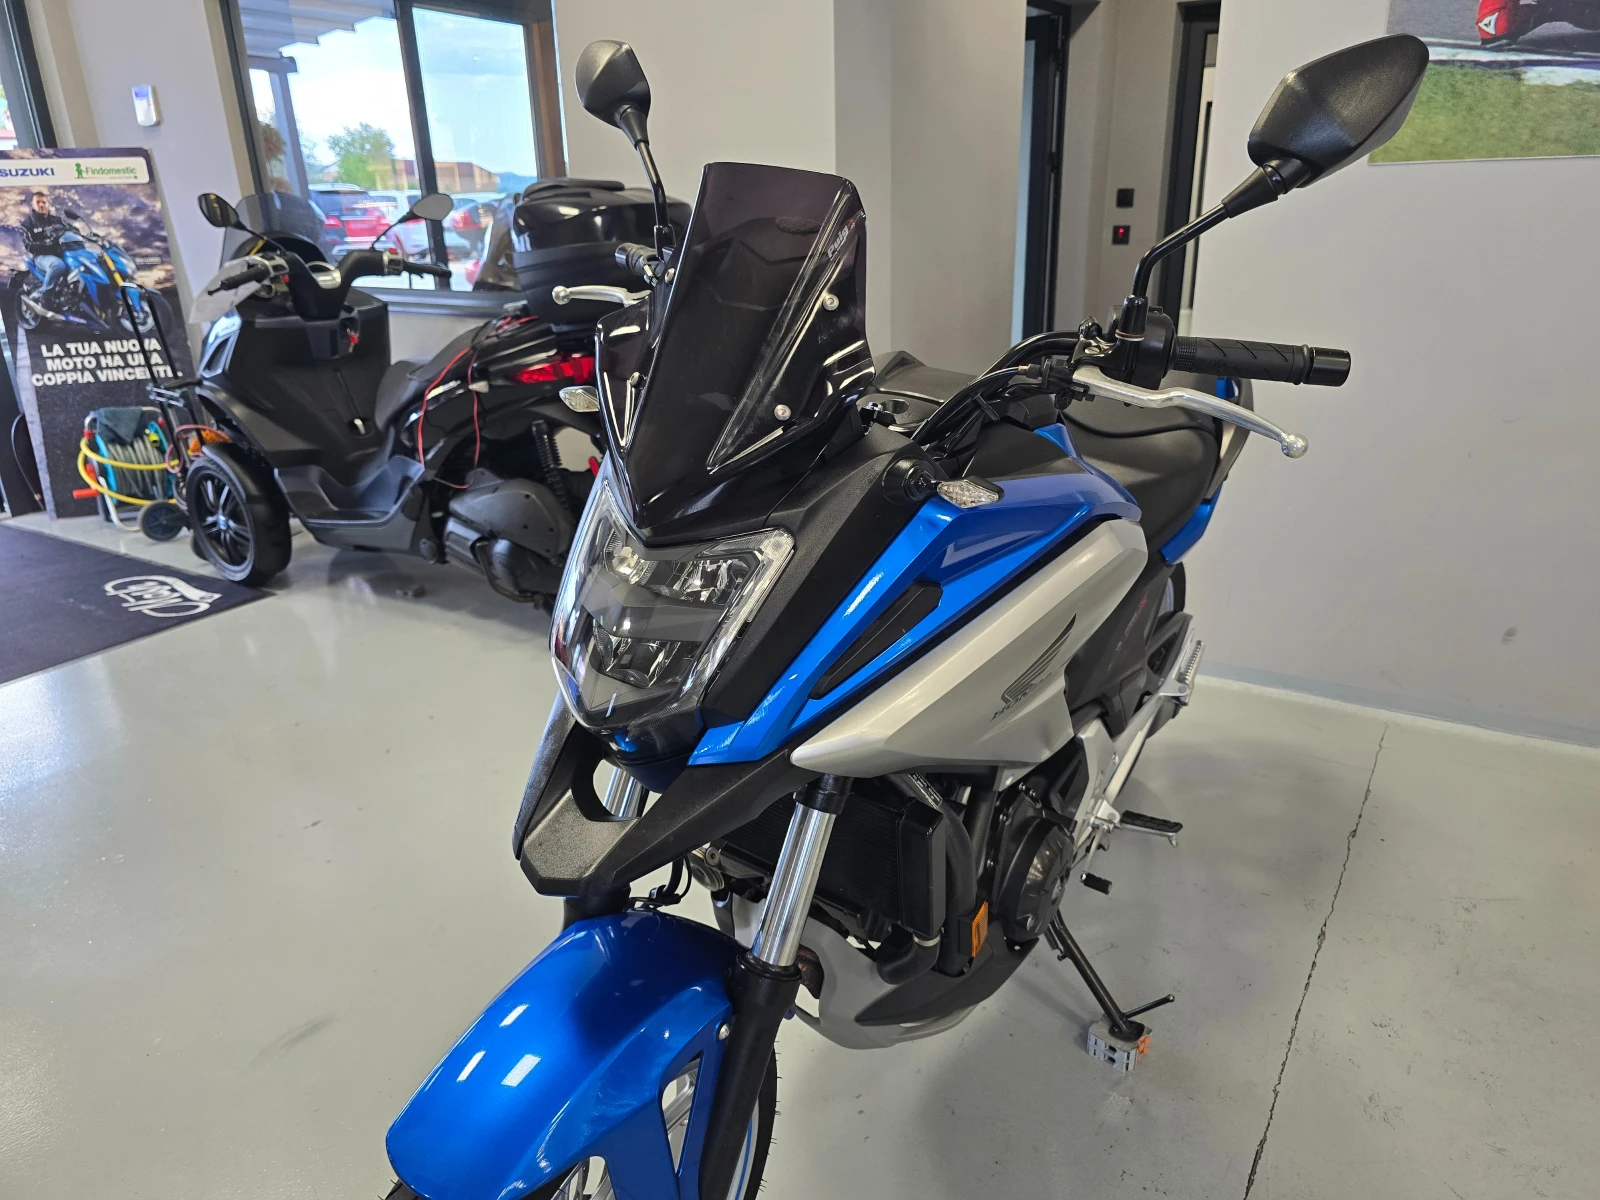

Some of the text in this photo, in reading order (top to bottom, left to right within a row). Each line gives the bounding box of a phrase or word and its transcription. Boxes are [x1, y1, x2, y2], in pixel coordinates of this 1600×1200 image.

[0, 167, 55, 177] SUZUKI
[85, 166, 137, 176] Findomestic
[827, 224, 849, 259] Puig
[40, 343, 65, 358] LA
[65, 341, 102, 356] TUA
[46, 355, 97, 371] MOTO
[99, 353, 125, 368] HA
[31, 370, 96, 387] COPPIA
[990, 670, 1053, 721] HON
